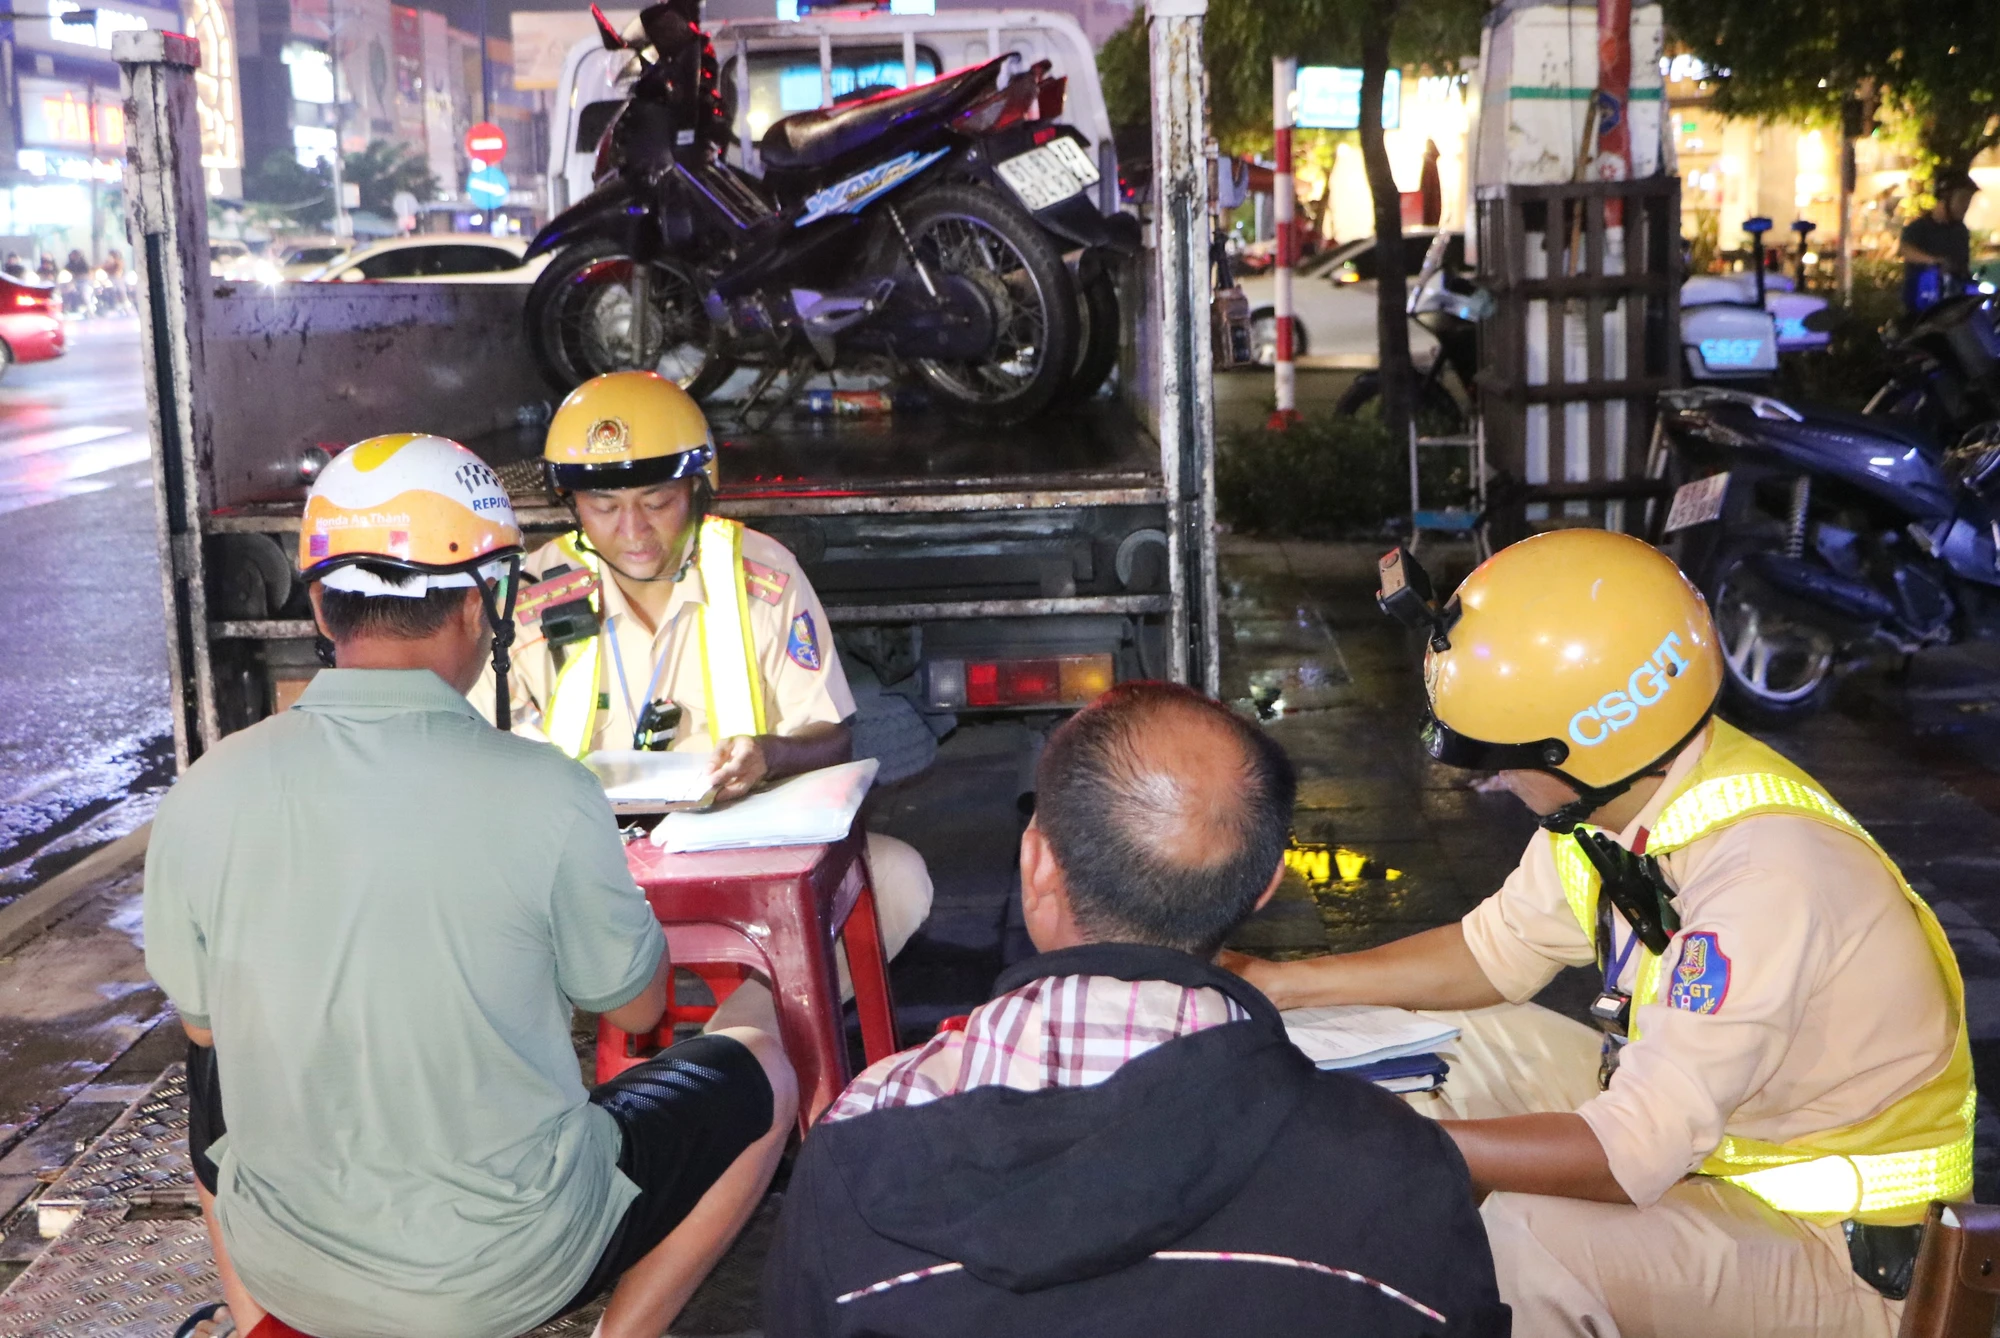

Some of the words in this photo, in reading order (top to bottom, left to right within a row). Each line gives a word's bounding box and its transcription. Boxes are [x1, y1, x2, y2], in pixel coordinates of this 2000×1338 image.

[316, 516, 348, 528] Honda
[370, 511, 410, 526] Thành
[1568, 631, 1690, 746] CSGT
